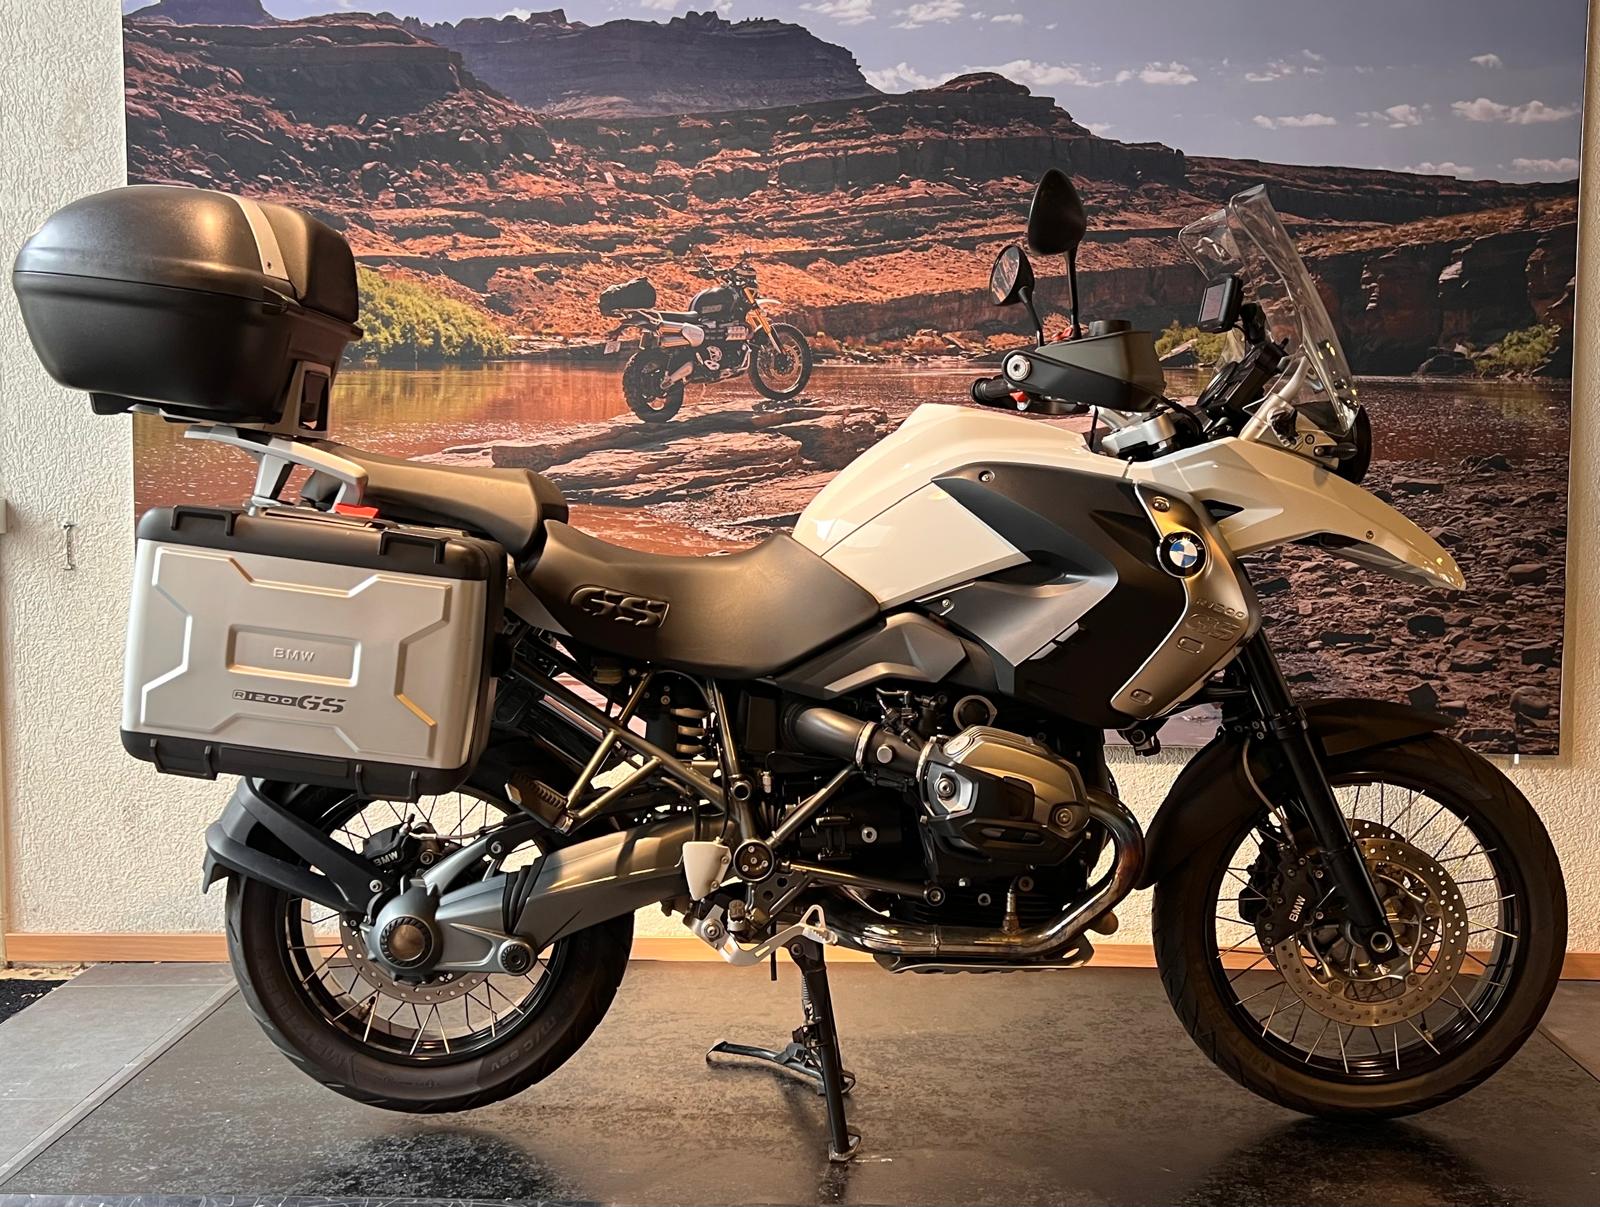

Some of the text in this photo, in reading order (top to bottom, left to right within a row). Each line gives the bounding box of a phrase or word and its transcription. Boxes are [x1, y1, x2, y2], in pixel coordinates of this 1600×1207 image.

[568, 584, 670, 628] GS
[272, 647, 316, 662] BMW
[373, 850, 399, 867] BMW
[1289, 895, 1306, 922] BMW
